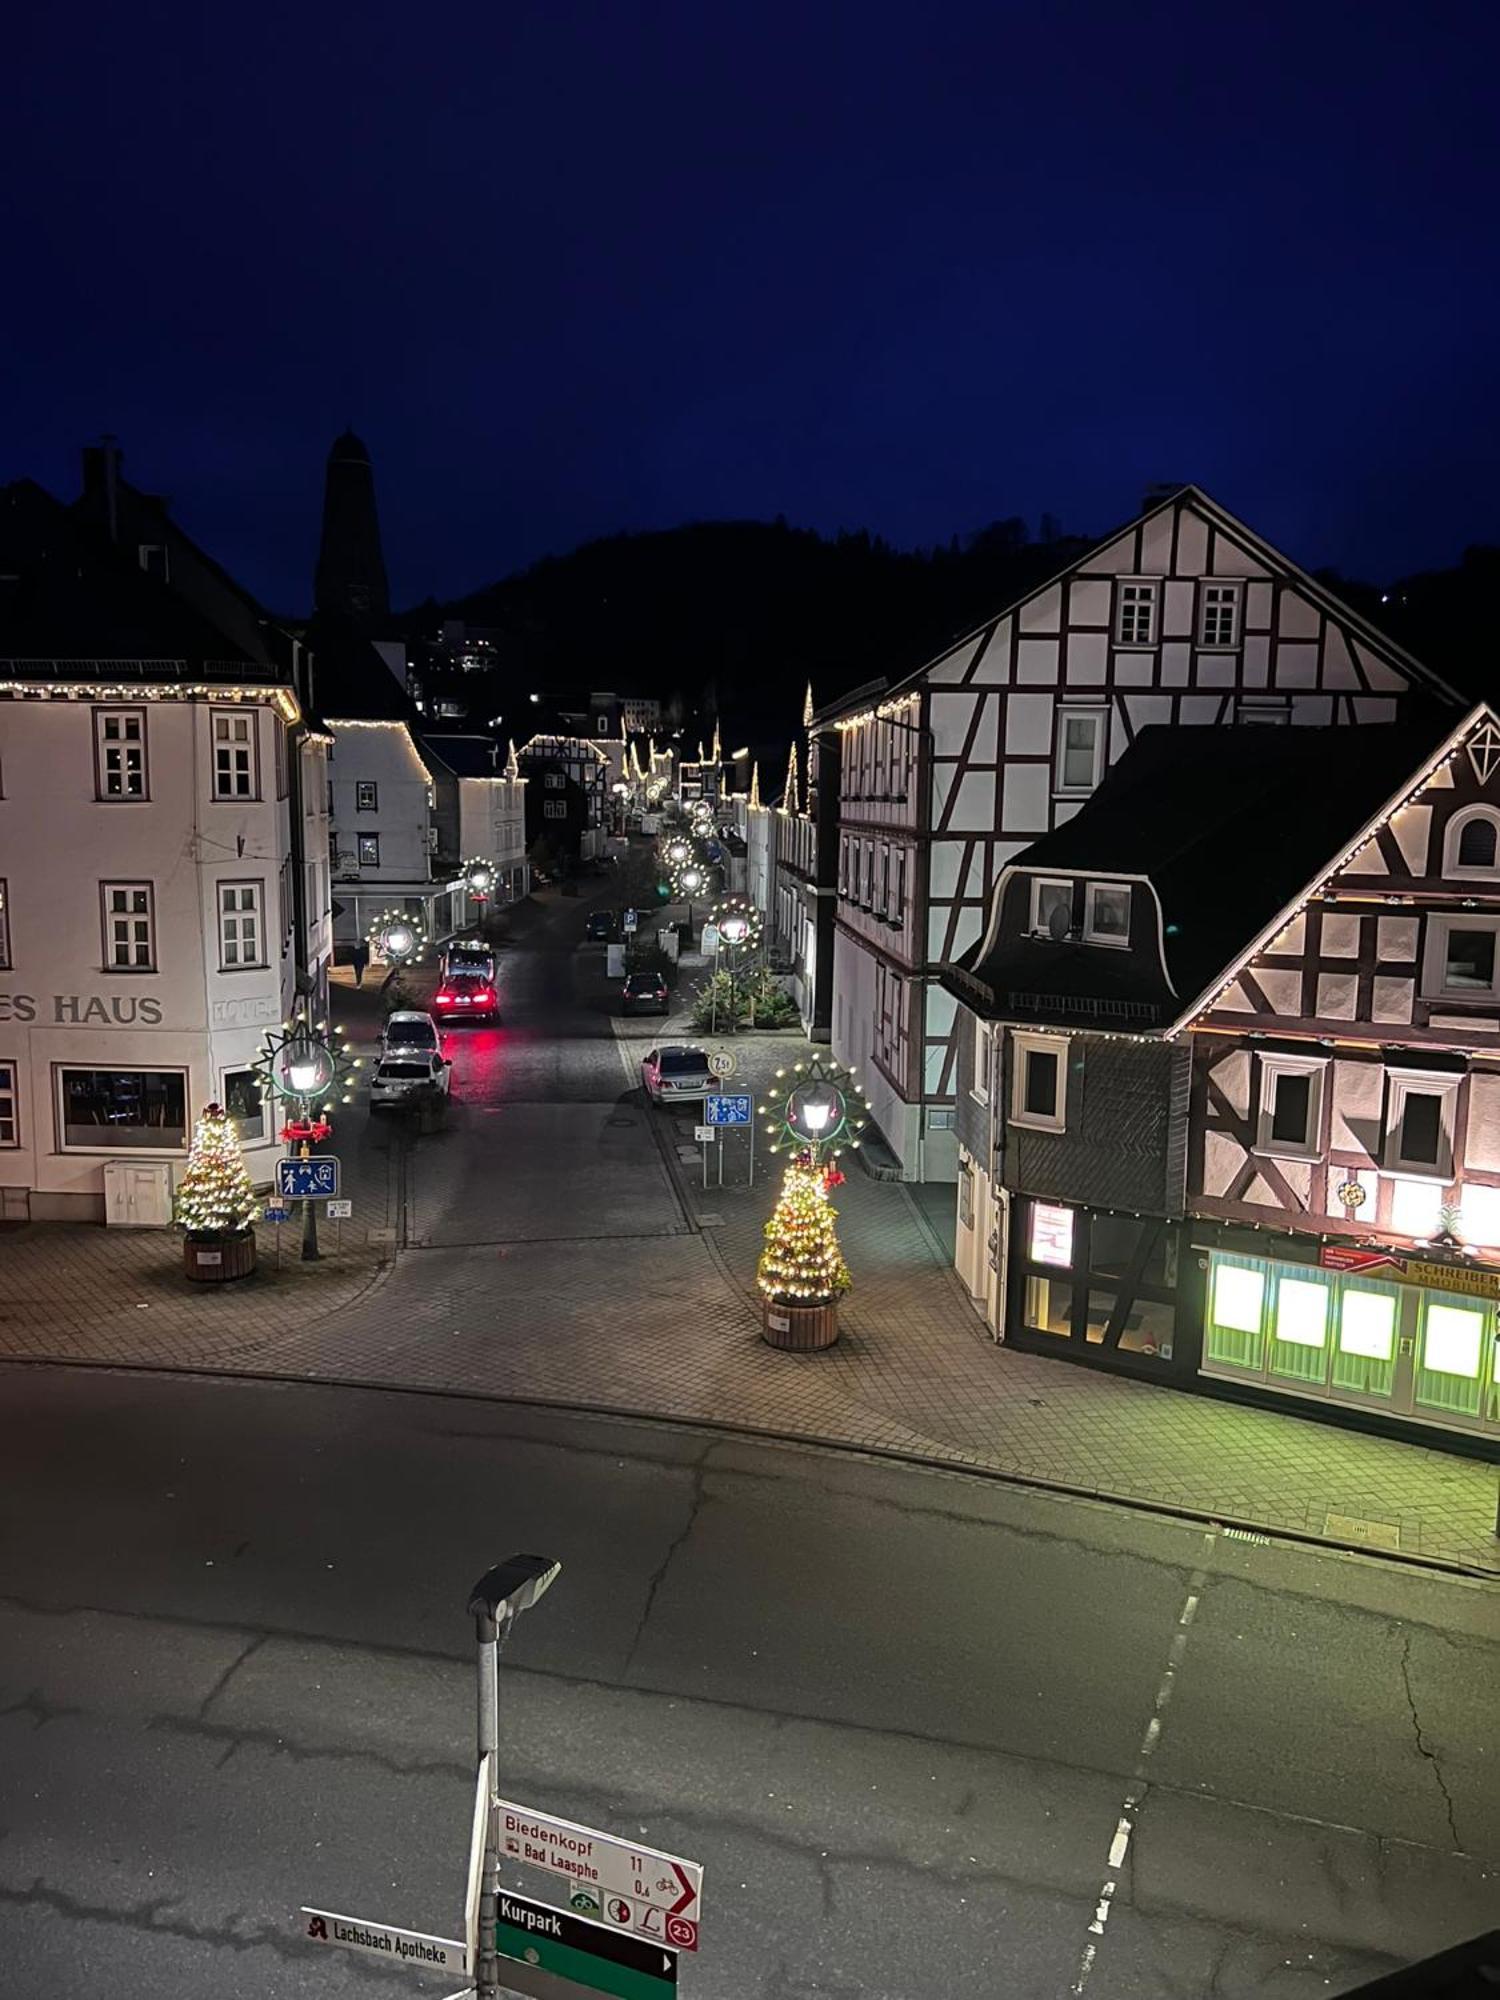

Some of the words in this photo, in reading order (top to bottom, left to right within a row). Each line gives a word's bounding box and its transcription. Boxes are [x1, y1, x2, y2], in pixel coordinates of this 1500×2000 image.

[54, 995, 162, 1024] HAUS
[1414, 1263, 1499, 1286] SCHREIBER
[505, 1815, 592, 1856] Biedenkopf
[630, 1856, 642, 1872] 11
[524, 1842, 546, 1862] Bad
[551, 1851, 599, 1880] Laasphe
[501, 1898, 561, 1936] Kurpark
[673, 1925, 690, 1939] 23
[334, 1922, 392, 1952] Lachsbach
[395, 1937, 446, 1964] Apotheke
